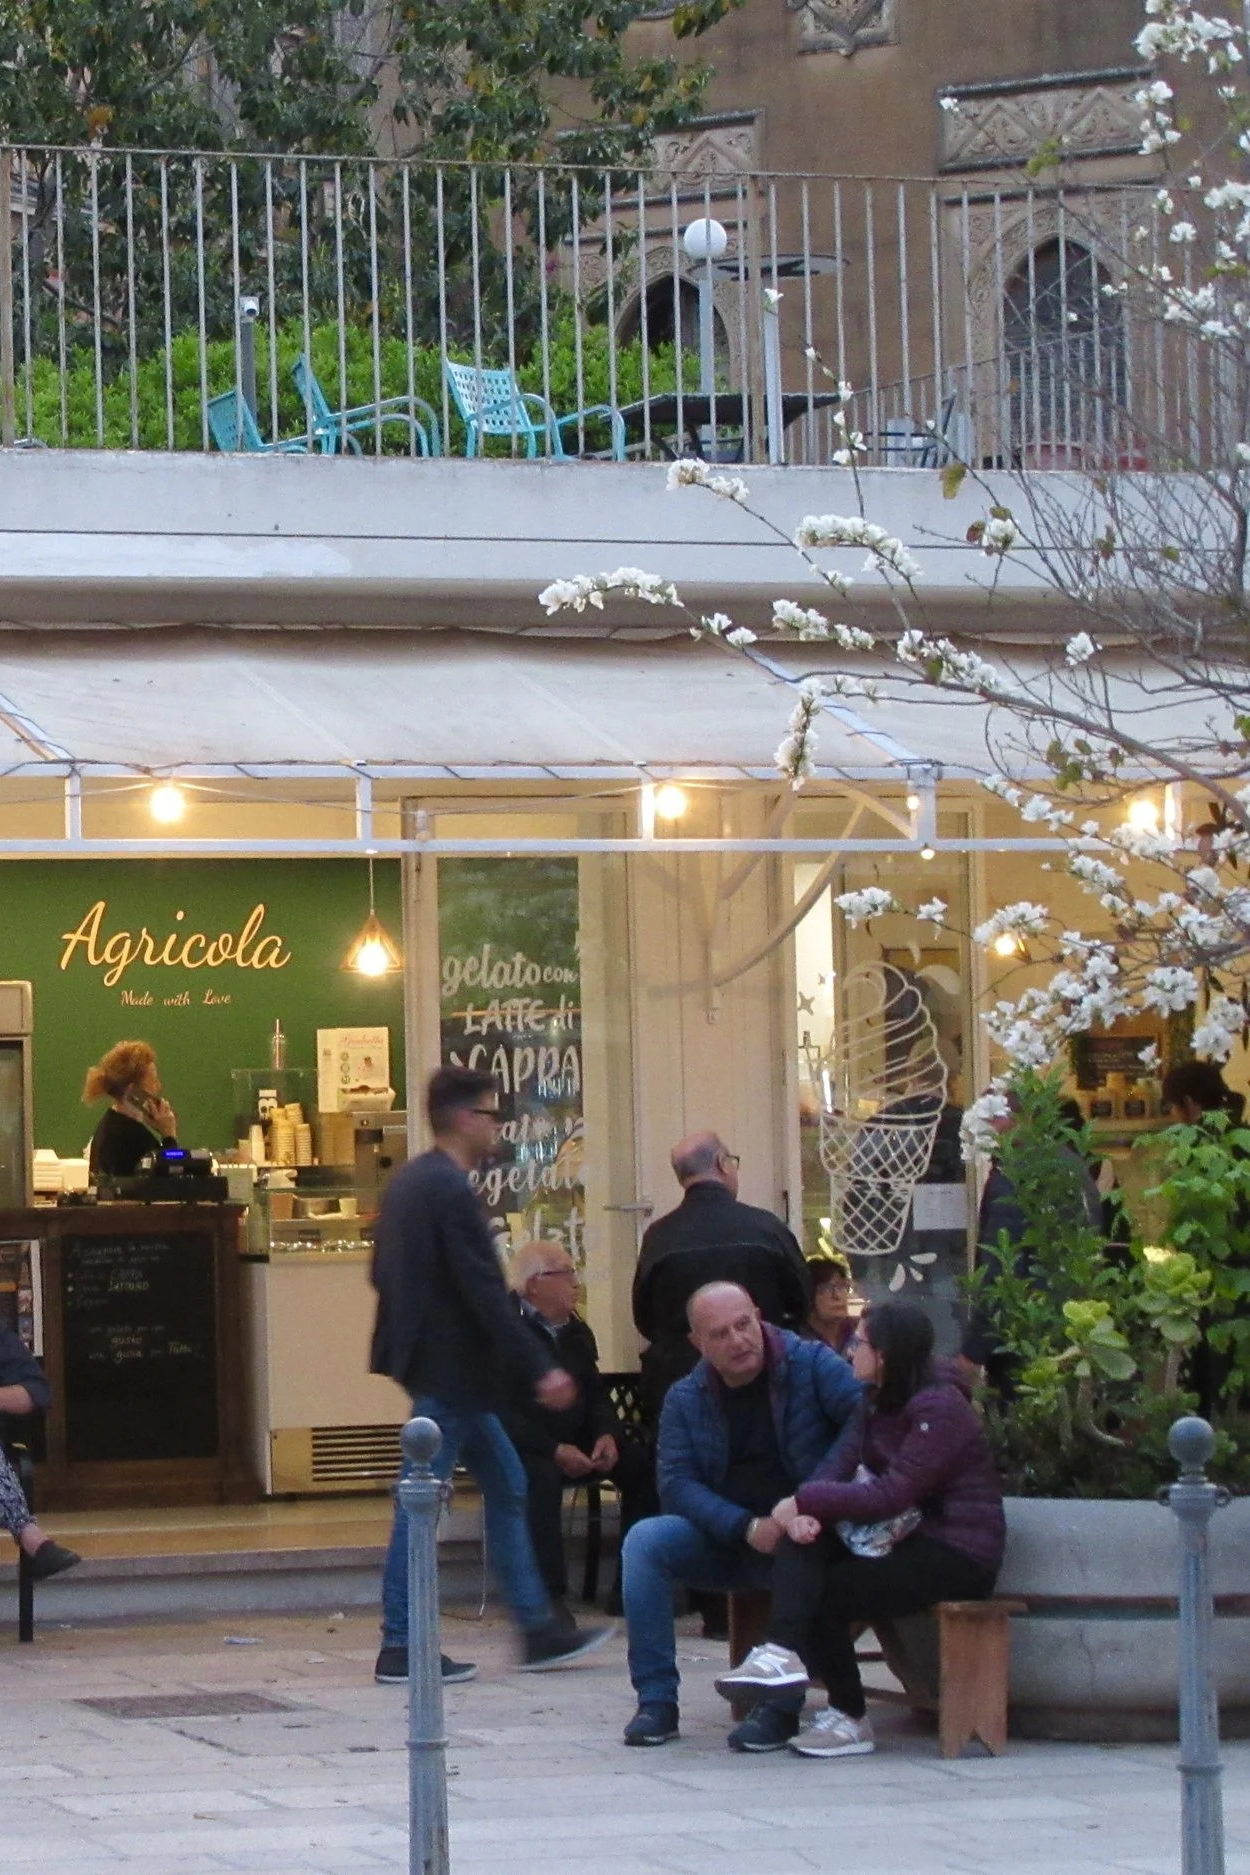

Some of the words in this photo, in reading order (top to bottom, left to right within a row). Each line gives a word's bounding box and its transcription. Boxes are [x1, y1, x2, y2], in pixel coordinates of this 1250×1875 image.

[60, 901, 291, 987] Agricola
[441, 944, 542, 998] gelato
[543, 966, 578, 984] con
[121, 989, 153, 1006] Made
[163, 991, 191, 1006] with
[202, 988, 231, 1005] Love
[463, 997, 545, 1036] LATTE
[550, 994, 574, 1031] di
